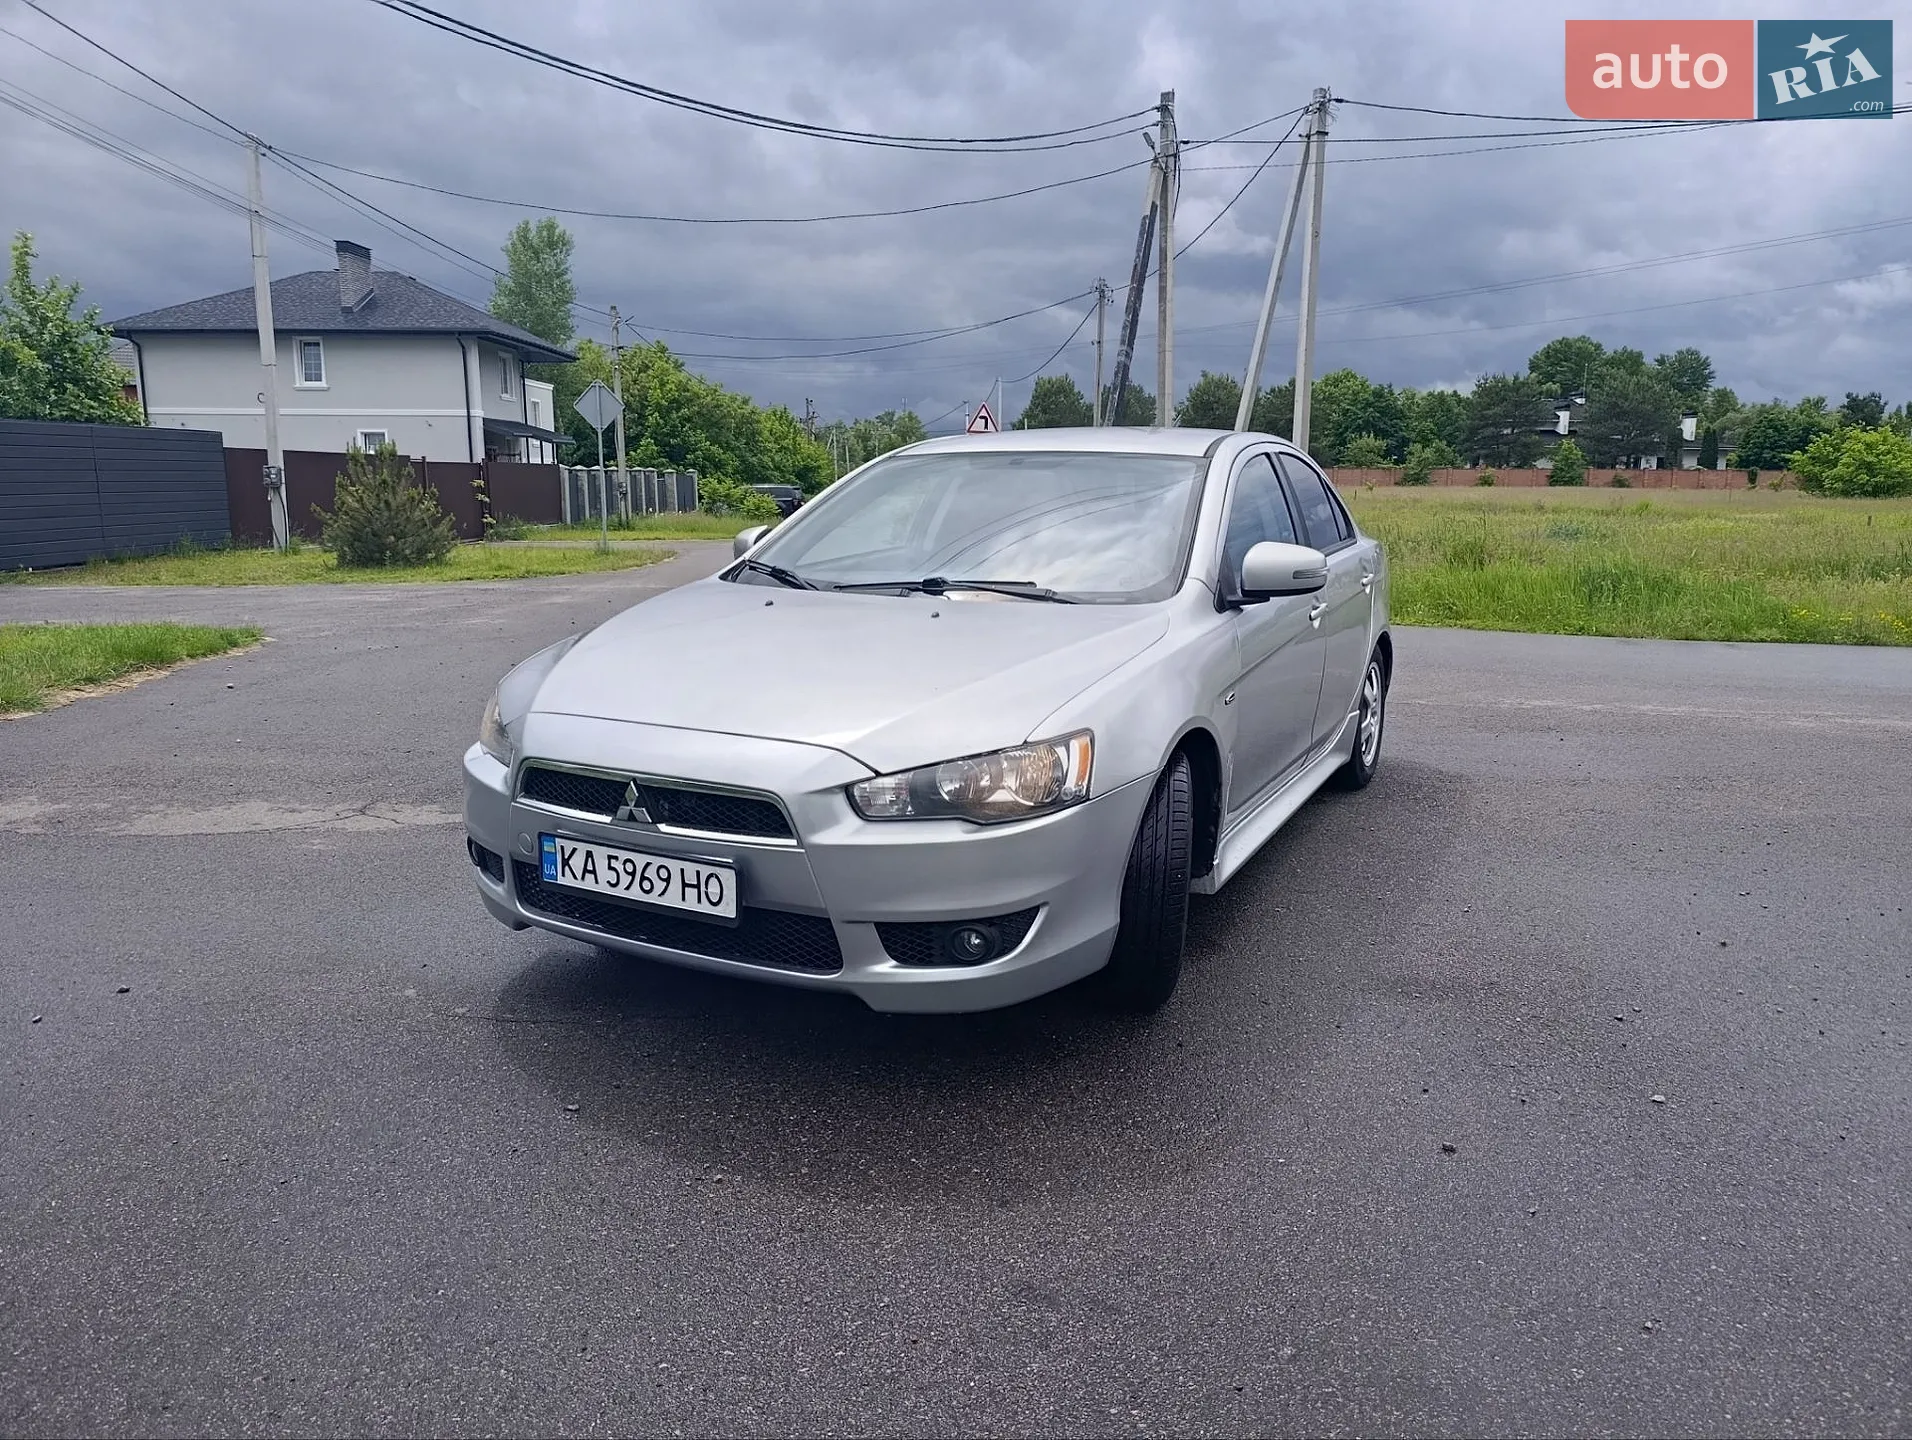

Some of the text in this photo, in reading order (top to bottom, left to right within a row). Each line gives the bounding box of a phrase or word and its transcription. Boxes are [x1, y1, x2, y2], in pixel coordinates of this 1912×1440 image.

[544, 864, 557, 877] UA
[559, 844, 724, 907] KA 5969 HO
